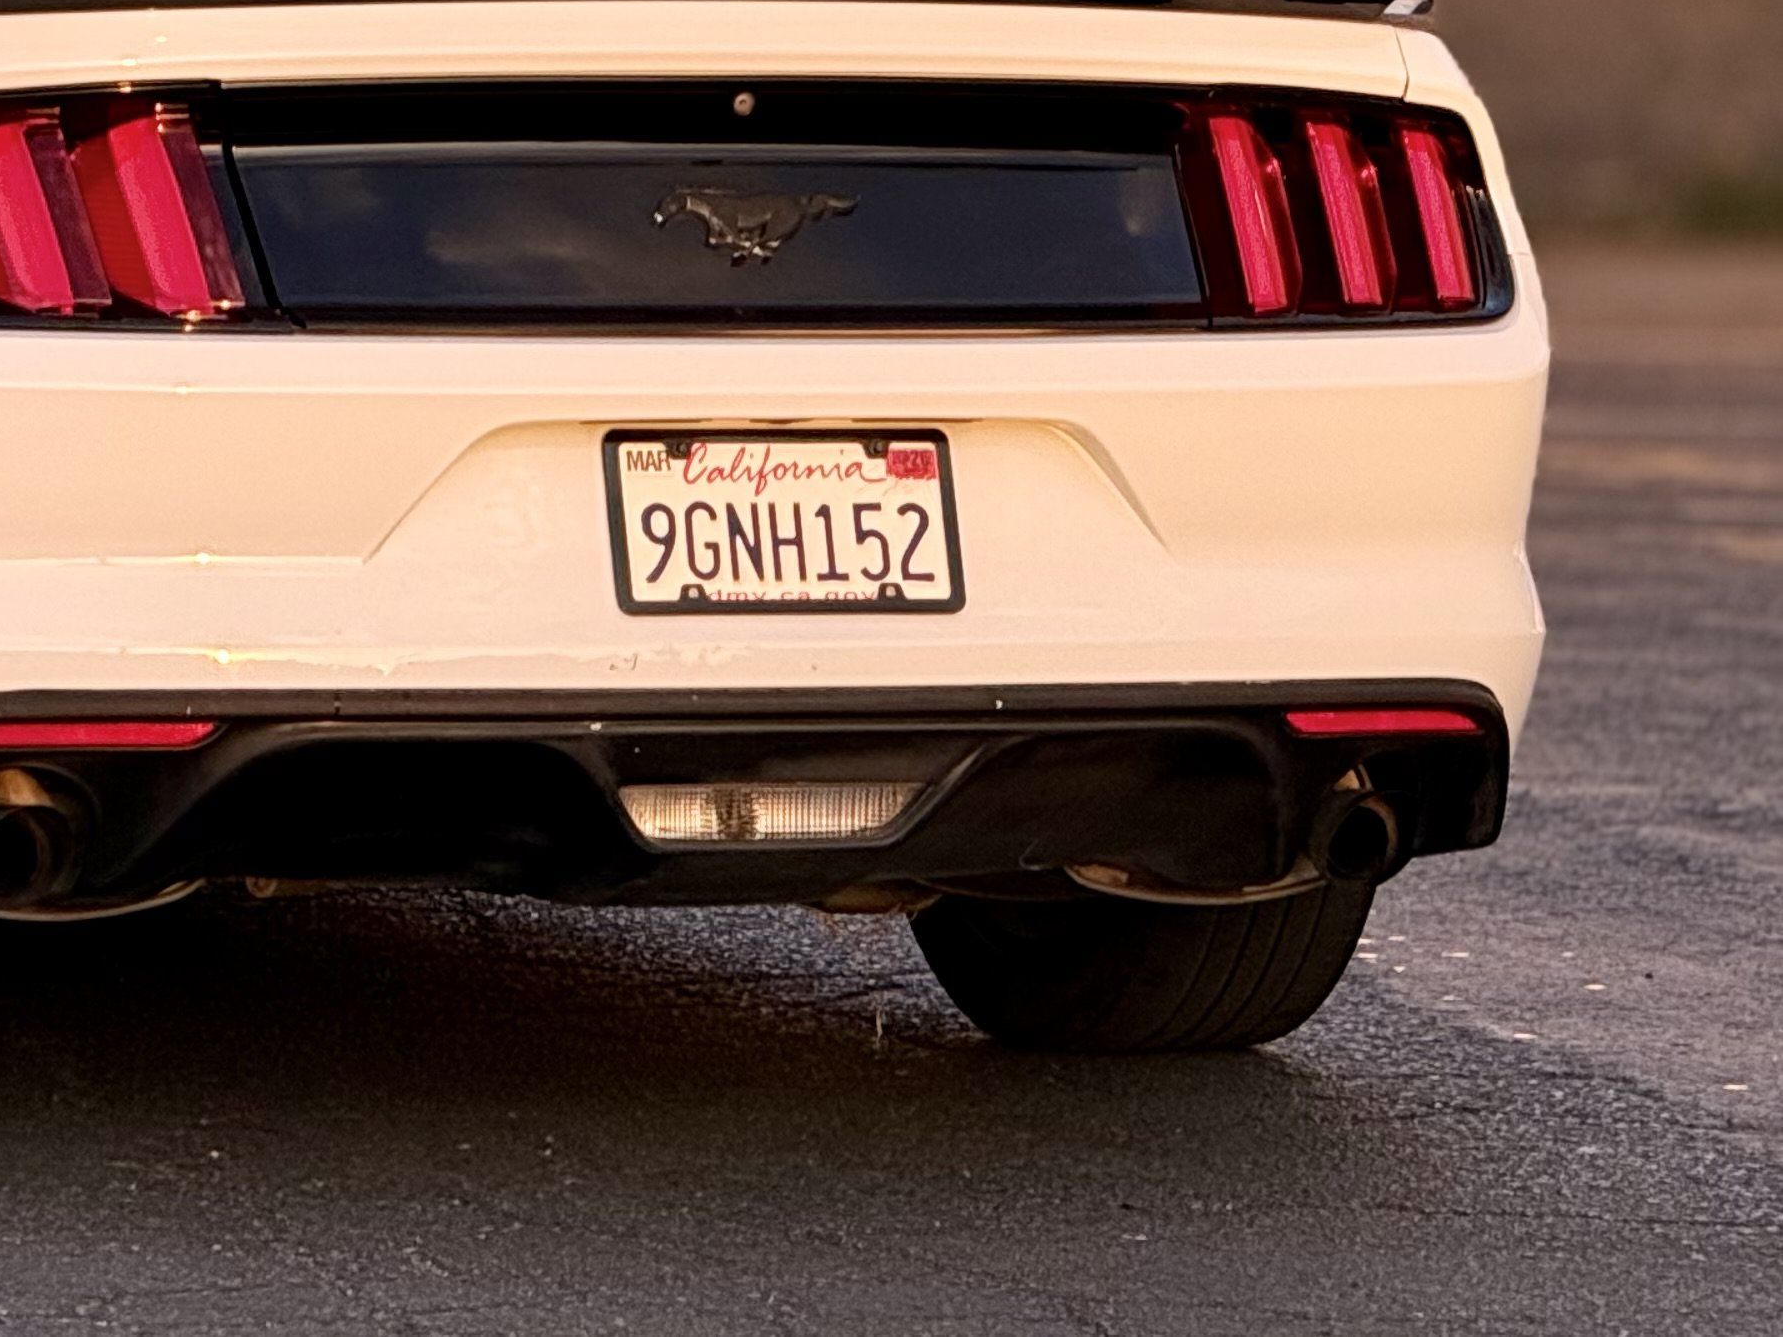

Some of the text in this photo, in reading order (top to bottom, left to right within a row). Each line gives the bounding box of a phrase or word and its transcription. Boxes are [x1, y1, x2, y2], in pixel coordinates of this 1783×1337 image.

[626, 449, 672, 472] MAR
[682, 441, 886, 497] California
[640, 500, 936, 584] 9GNH152
